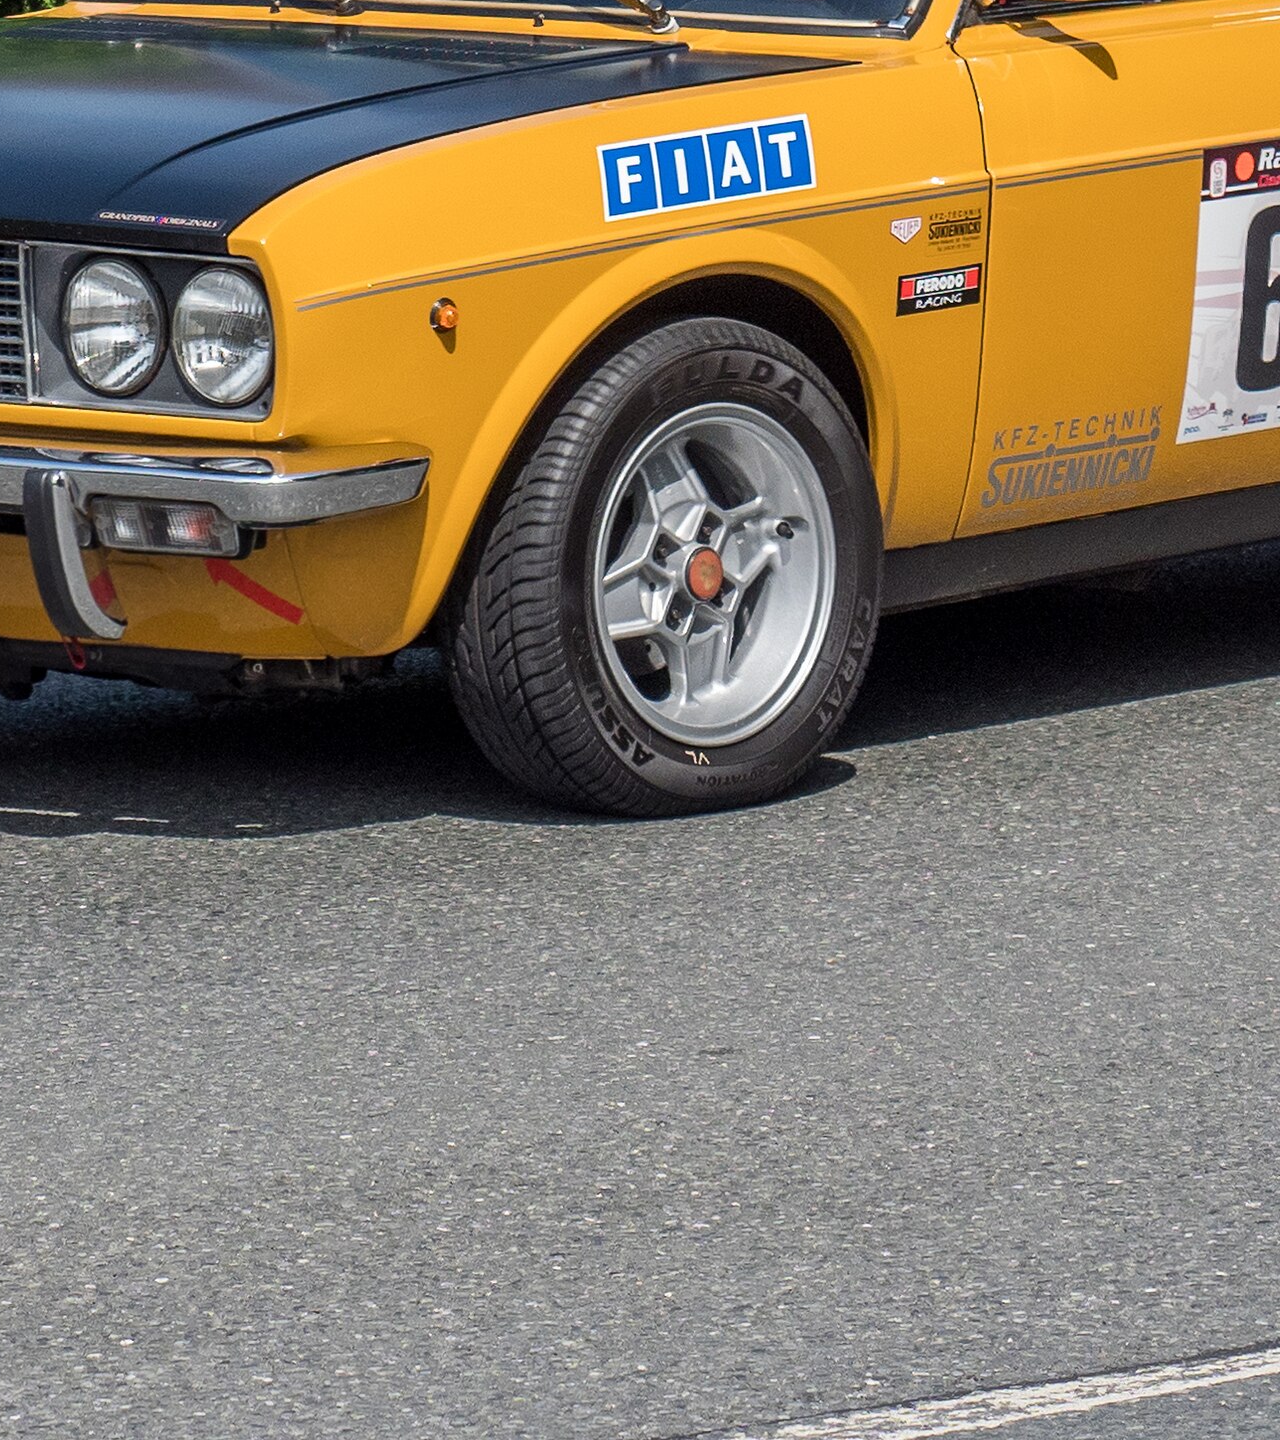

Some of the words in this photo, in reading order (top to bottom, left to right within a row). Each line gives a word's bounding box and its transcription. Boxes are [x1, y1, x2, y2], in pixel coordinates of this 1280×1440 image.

[617, 131, 798, 204] FIAT
[916, 273, 964, 294] FERODO
[915, 293, 963, 309] RACING
[993, 405, 1162, 451] KFZ-TECHNIK
